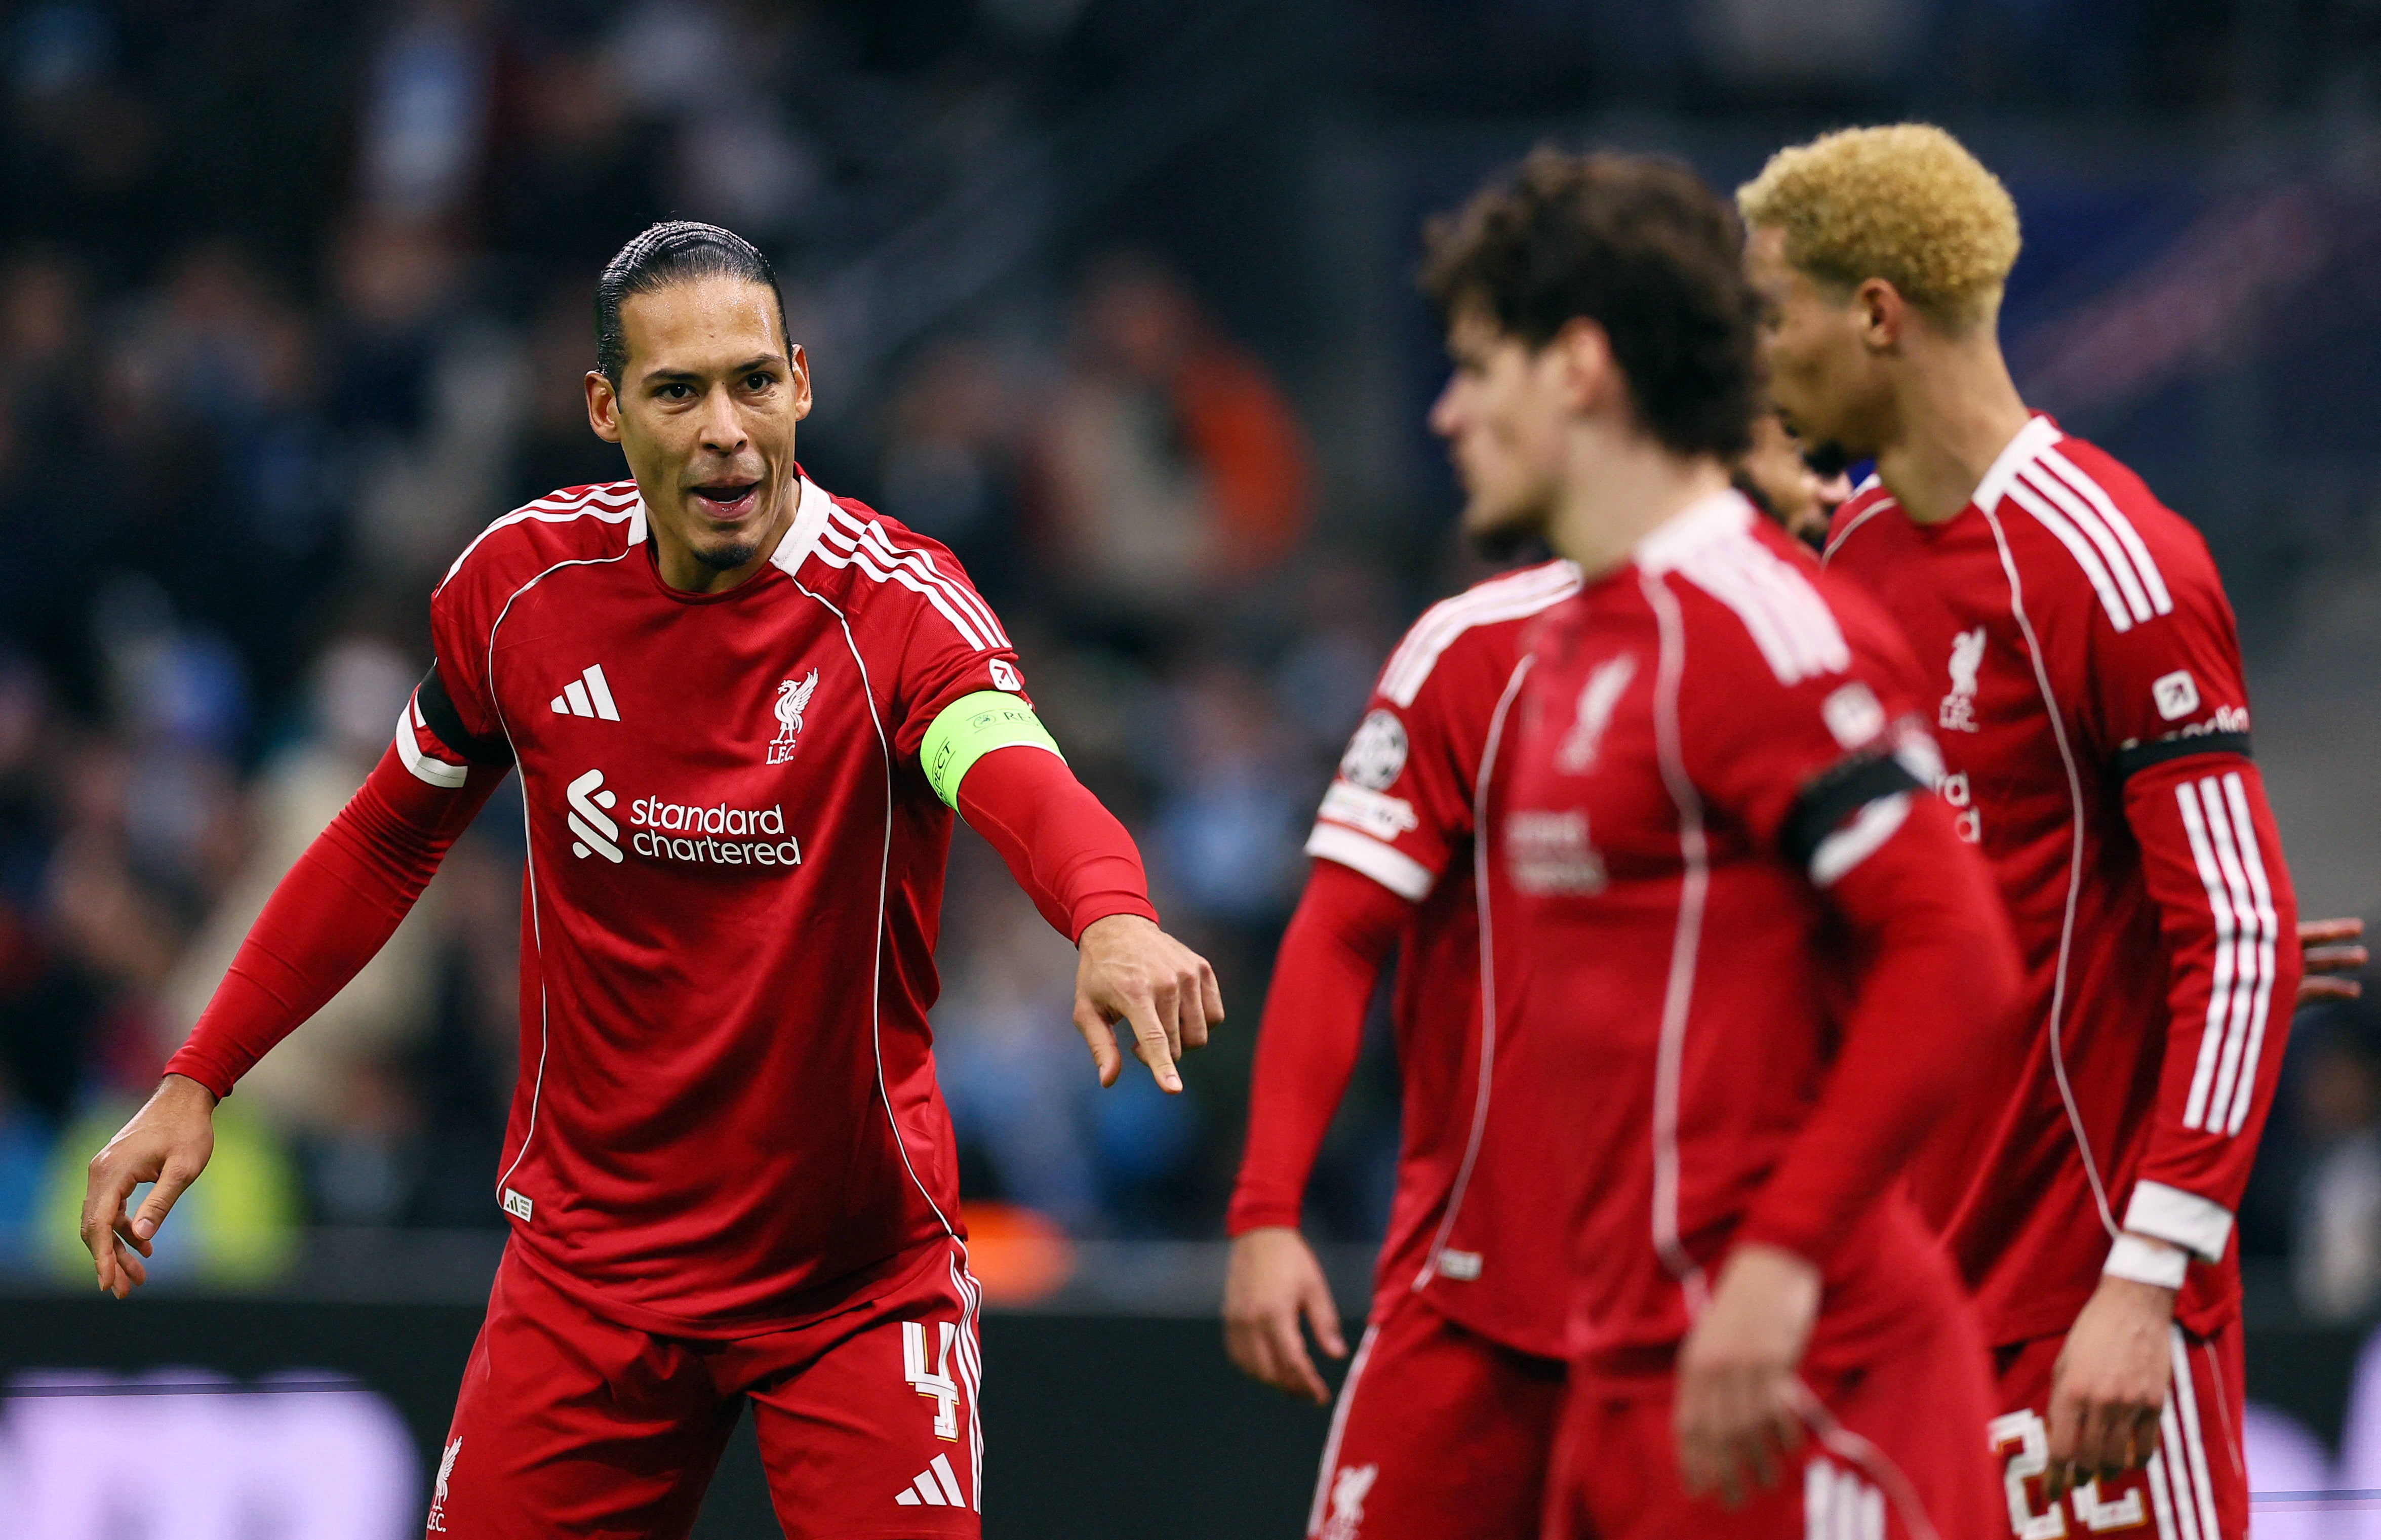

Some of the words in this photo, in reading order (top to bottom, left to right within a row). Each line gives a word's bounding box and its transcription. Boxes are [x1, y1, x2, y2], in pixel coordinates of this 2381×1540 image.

[765, 744, 796, 765] L.F.C.
[629, 795, 784, 835] standard
[632, 829, 802, 865] chartered
[902, 1321, 960, 1443] 4
